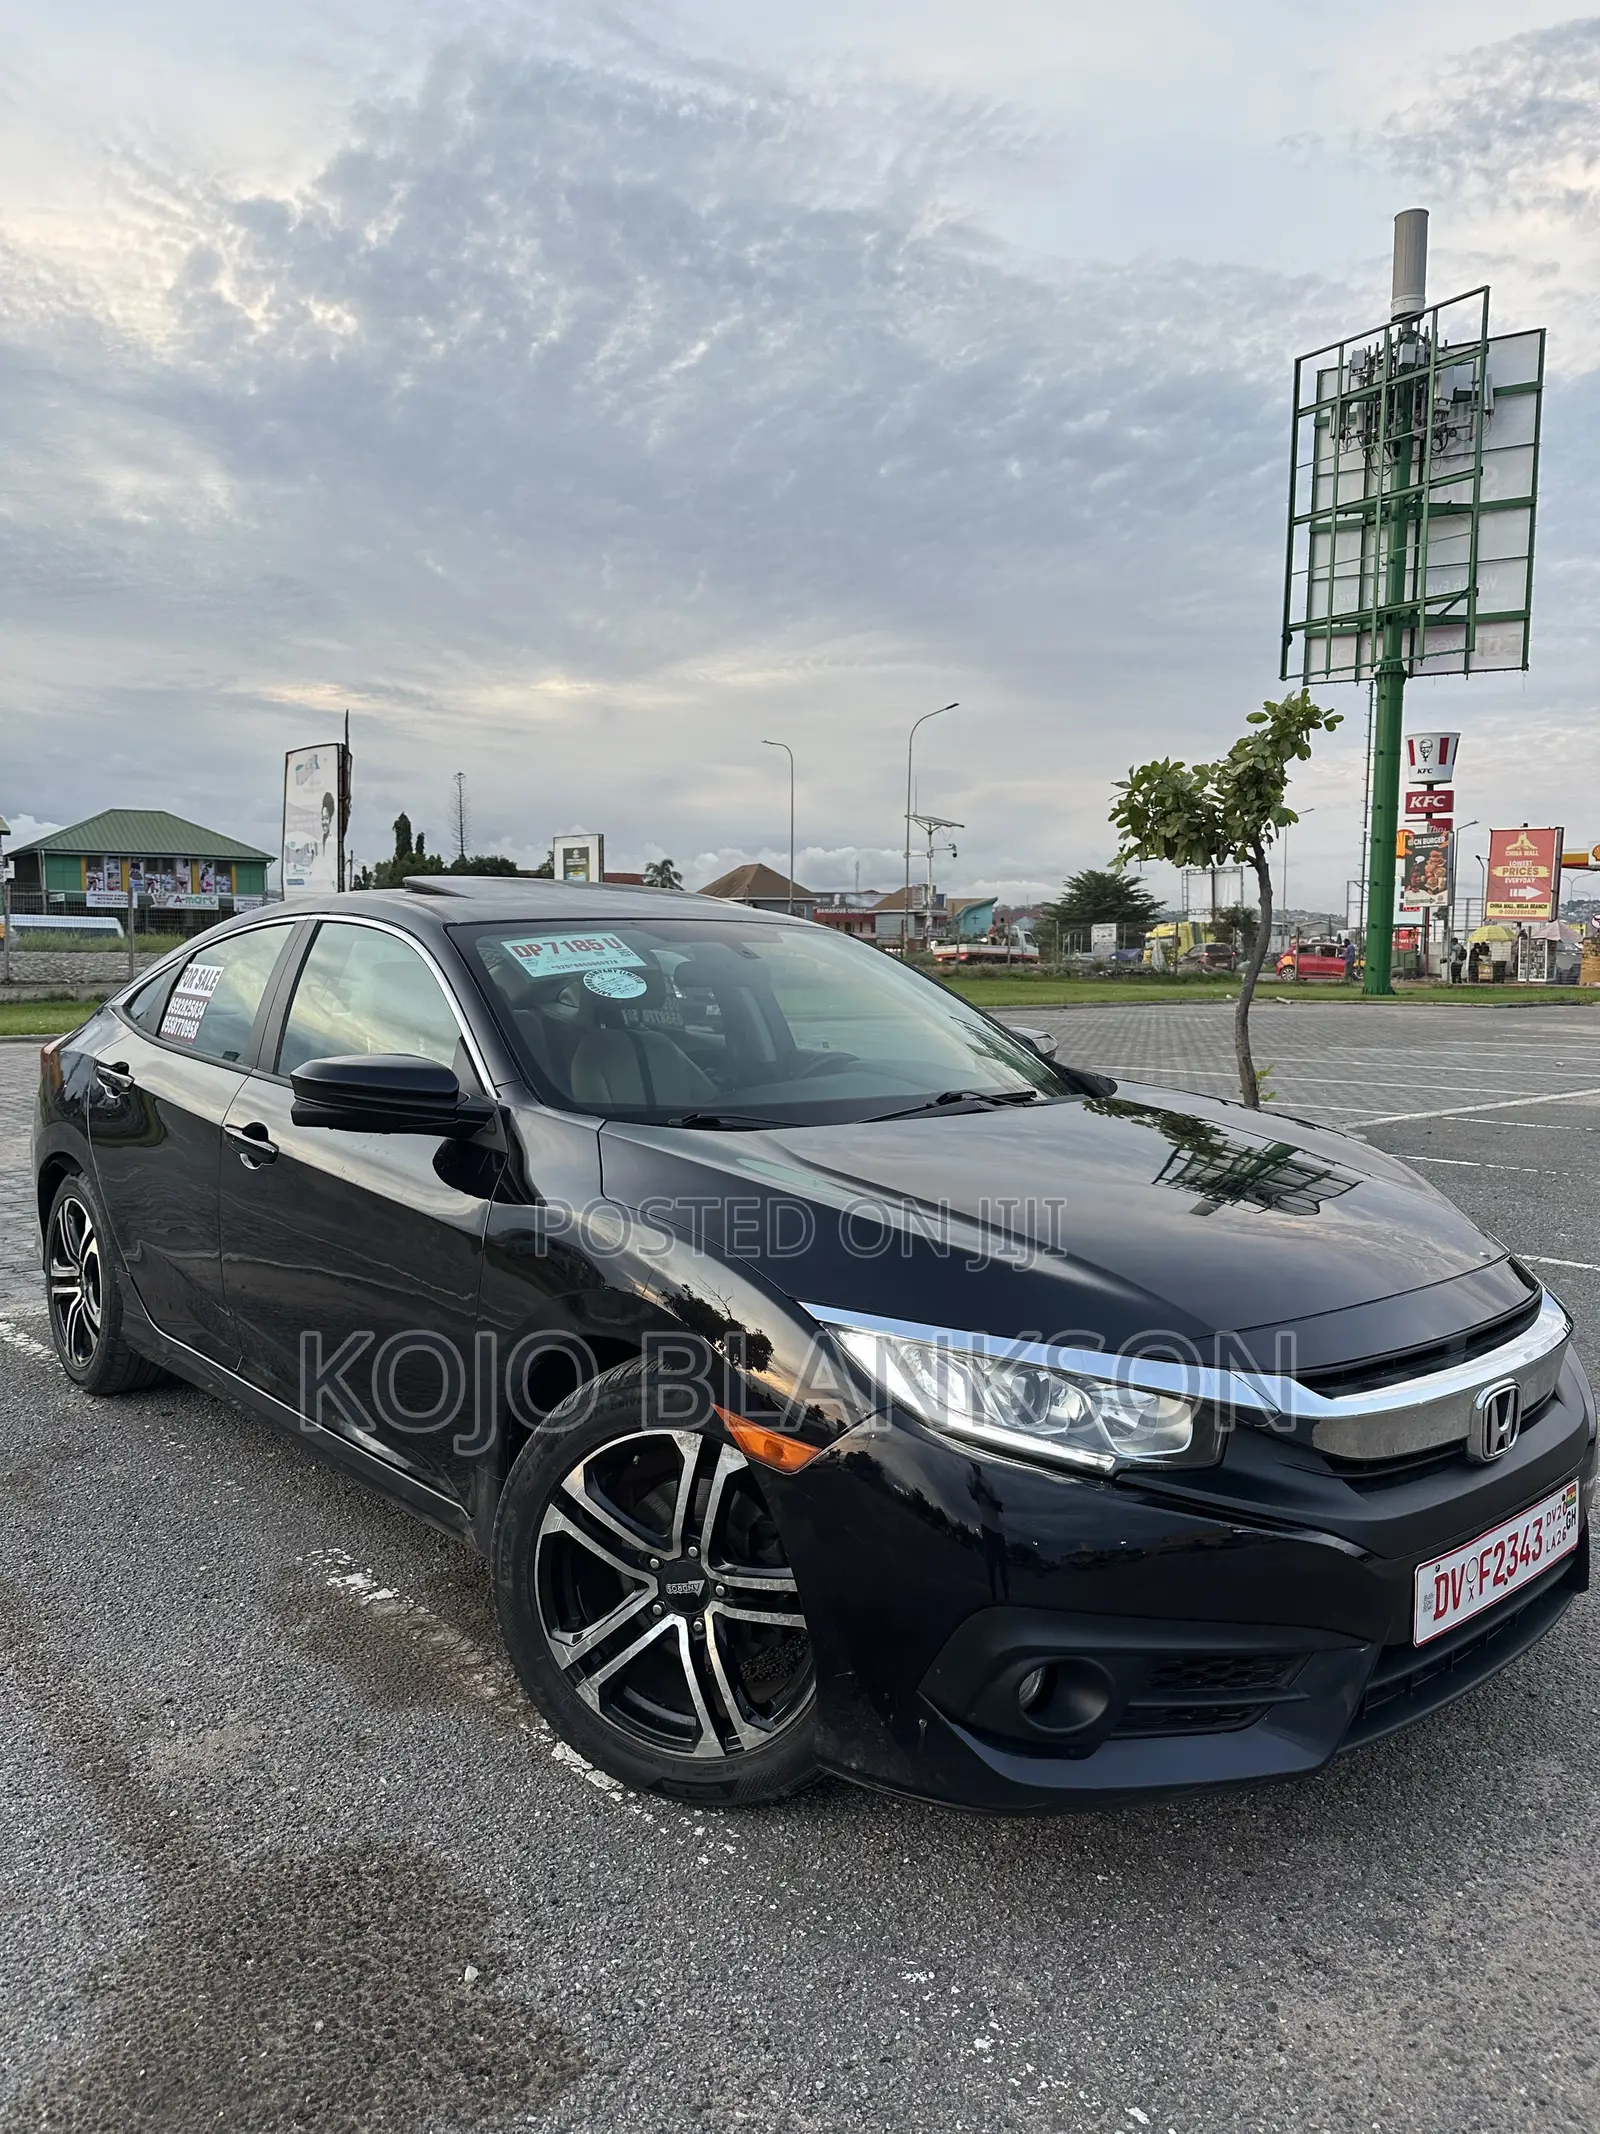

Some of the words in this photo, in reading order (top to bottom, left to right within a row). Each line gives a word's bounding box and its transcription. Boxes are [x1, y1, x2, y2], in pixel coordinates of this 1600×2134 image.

[1409, 795, 1446, 809] KFC
[1423, 836, 1446, 845] BURGER
[1502, 867, 1539, 876] PRICES
[510, 943, 544, 958] DP
[542, 938, 605, 955] 7185
[602, 937, 623, 949] U
[178, 967, 199, 989] FOR
[194, 968, 222, 992] SALE
[1565, 1507, 1577, 1531] GH
[1433, 1562, 1465, 1622] DV
[1479, 1516, 1544, 1596] F2343
[667, 1583, 699, 1593] ANDROS
